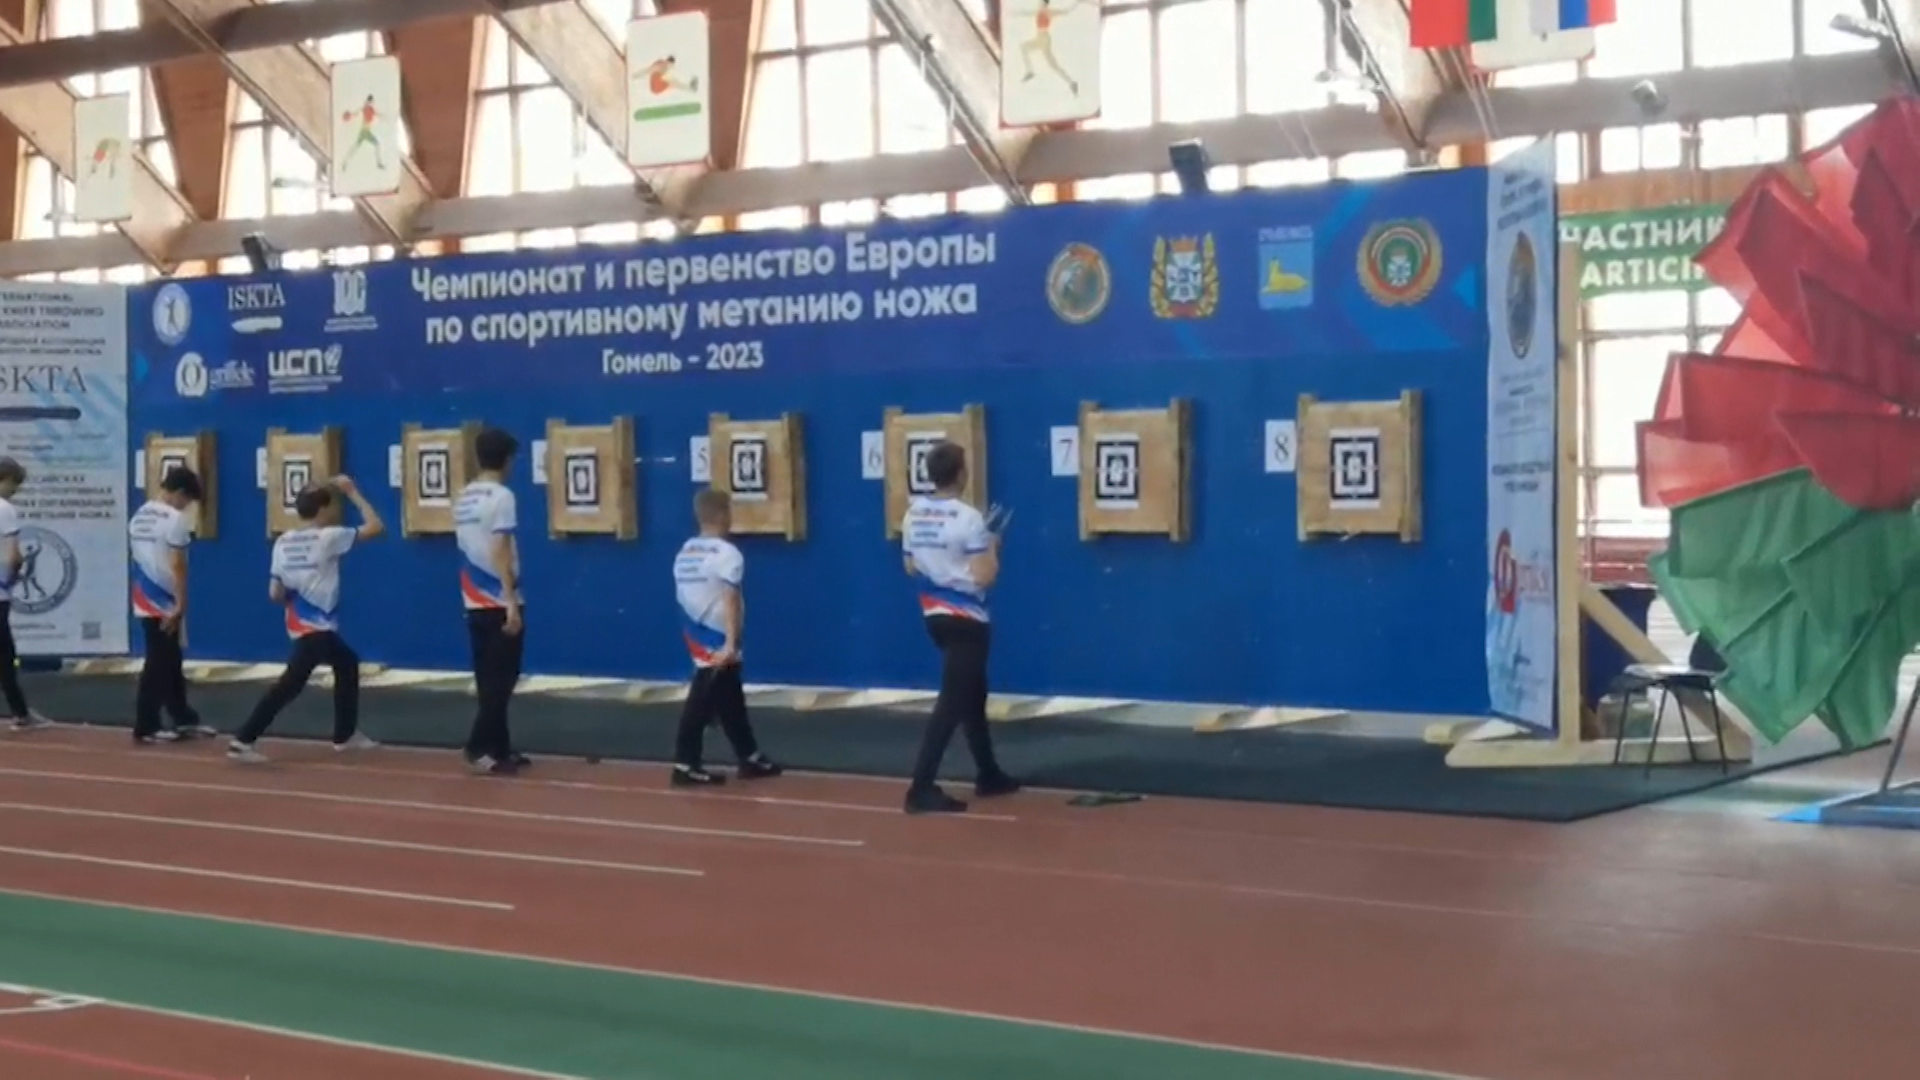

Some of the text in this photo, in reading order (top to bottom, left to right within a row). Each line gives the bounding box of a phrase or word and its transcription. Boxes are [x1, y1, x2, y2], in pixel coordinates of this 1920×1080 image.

[411, 232, 996, 301] Чемпионат и первенство Европы
[228, 283, 286, 310] ISKTA
[426, 283, 977, 348] по спортивному метанию ножа
[602, 348, 682, 375] Гомель
[706, 341, 764, 370] 2023
[1058, 438, 1073, 466] 7
[1274, 434, 1290, 463] 8
